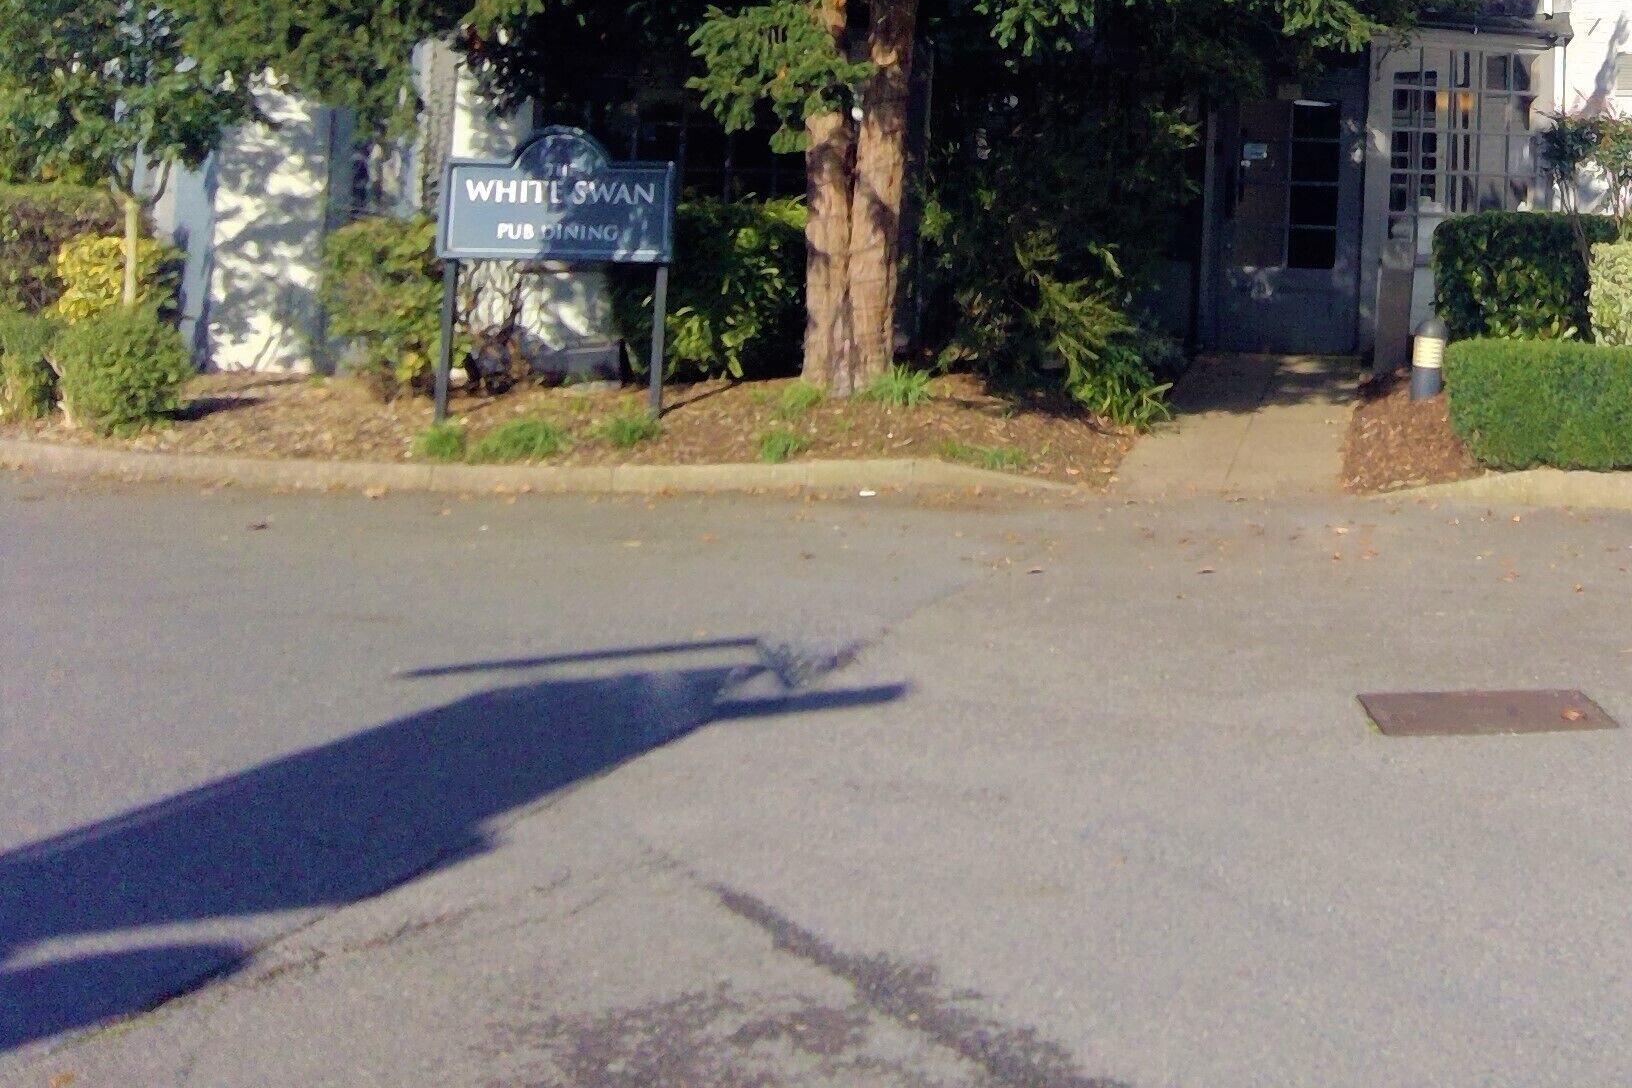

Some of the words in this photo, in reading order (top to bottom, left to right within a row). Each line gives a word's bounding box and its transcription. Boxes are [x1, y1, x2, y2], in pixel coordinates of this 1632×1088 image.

[466, 179, 562, 204] WHITE
[572, 180, 655, 205] SWAN
[496, 223, 534, 241] PUB
[541, 224, 619, 242] DINING
